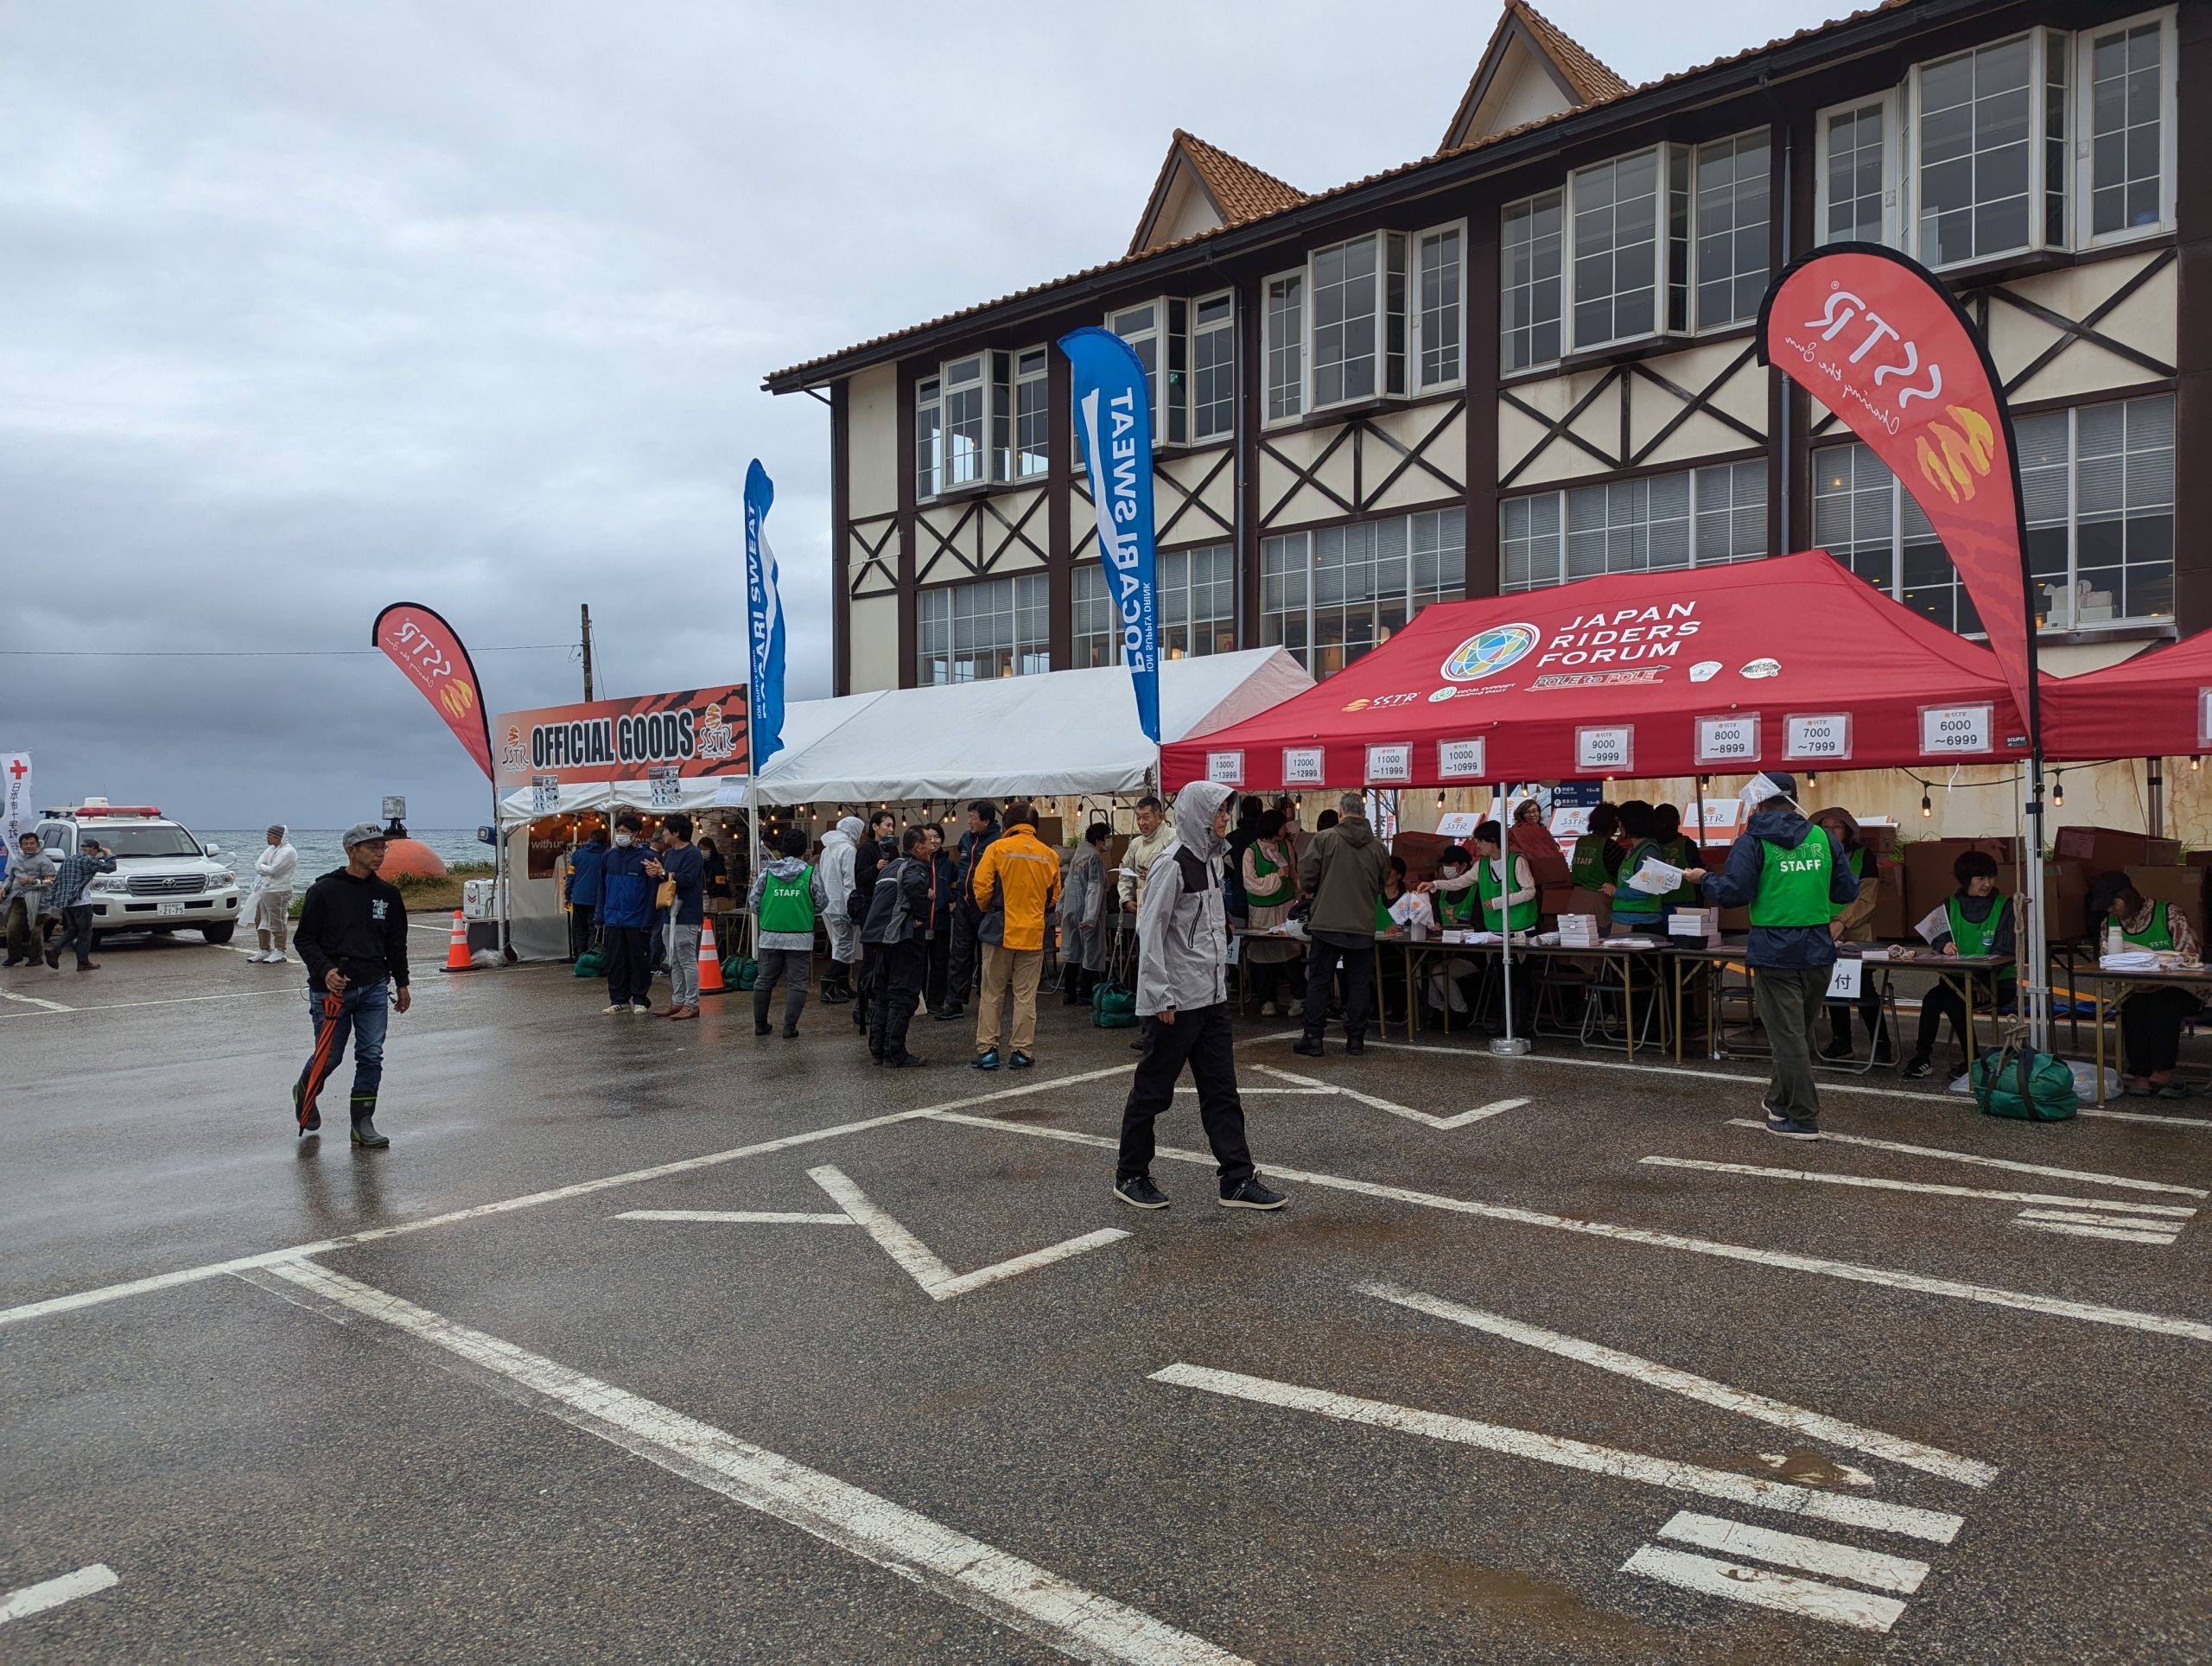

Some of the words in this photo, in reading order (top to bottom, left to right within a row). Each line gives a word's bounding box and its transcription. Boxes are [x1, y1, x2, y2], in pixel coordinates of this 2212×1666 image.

[747, 499, 761, 604] SWEAT
[1560, 601, 1697, 632] JAPAN
[1548, 620, 1702, 650] RIDERS
[1536, 640, 1682, 668] FORUM
[1535, 675, 1582, 688] POLE
[1605, 669, 1657, 684] POLE
[1373, 692, 1418, 706] SSTR
[1940, 720, 1971, 731] 6000
[532, 718, 614, 768] OFFICIAL
[618, 709, 694, 763] GOODS
[698, 724, 736, 750] SSTR
[1714, 729, 1740, 741] 8000
[1804, 728, 1831, 738] 7000
[1592, 740, 1615, 749] 9000
[502, 744, 529, 765] SSTR
[1377, 755, 1400, 764] 11000
[1449, 750, 1473, 760] 10000
[531, 839, 552, 849] with
[1573, 856, 1592, 866] STAFF
[1780, 859, 1821, 873] STAFF
[773, 888, 801, 897] STAFF
[1834, 973, 1852, 989] 付
